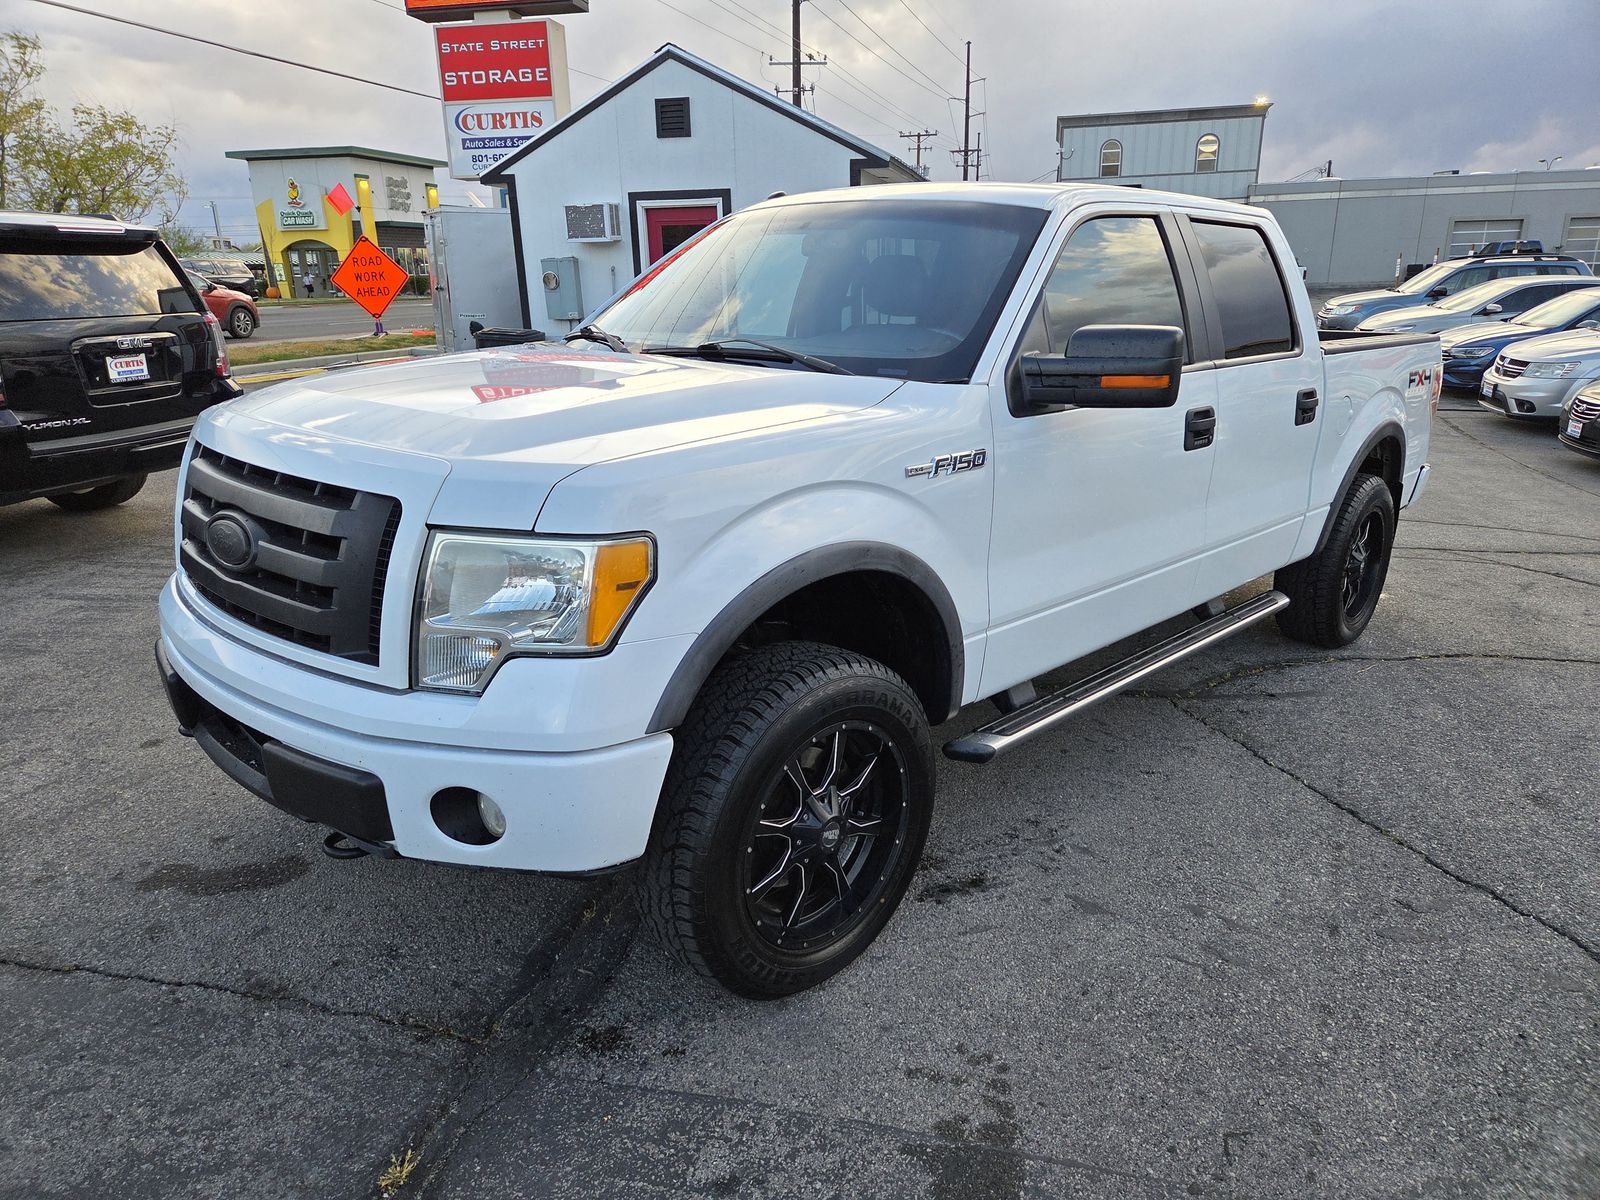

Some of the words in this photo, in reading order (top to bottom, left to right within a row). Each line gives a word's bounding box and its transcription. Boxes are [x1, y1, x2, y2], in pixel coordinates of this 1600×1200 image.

[445, 68, 548, 86] STORAGE
[461, 110, 544, 131] CURTIS
[464, 140, 484, 149] Auto
[484, 138, 505, 148] Sales
[505, 137, 513, 147] &
[283, 217, 296, 225] CAR
[295, 216, 314, 224] WASH
[352, 256, 382, 267] ROAD
[354, 271, 386, 282] WORK
[356, 286, 390, 297] AHEAD
[117, 337, 152, 349] GMC
[114, 359, 145, 369] CURTIS
[1407, 369, 1432, 388] FX4
[22, 419, 71, 431] YUKON
[72, 417, 92, 426] XL
